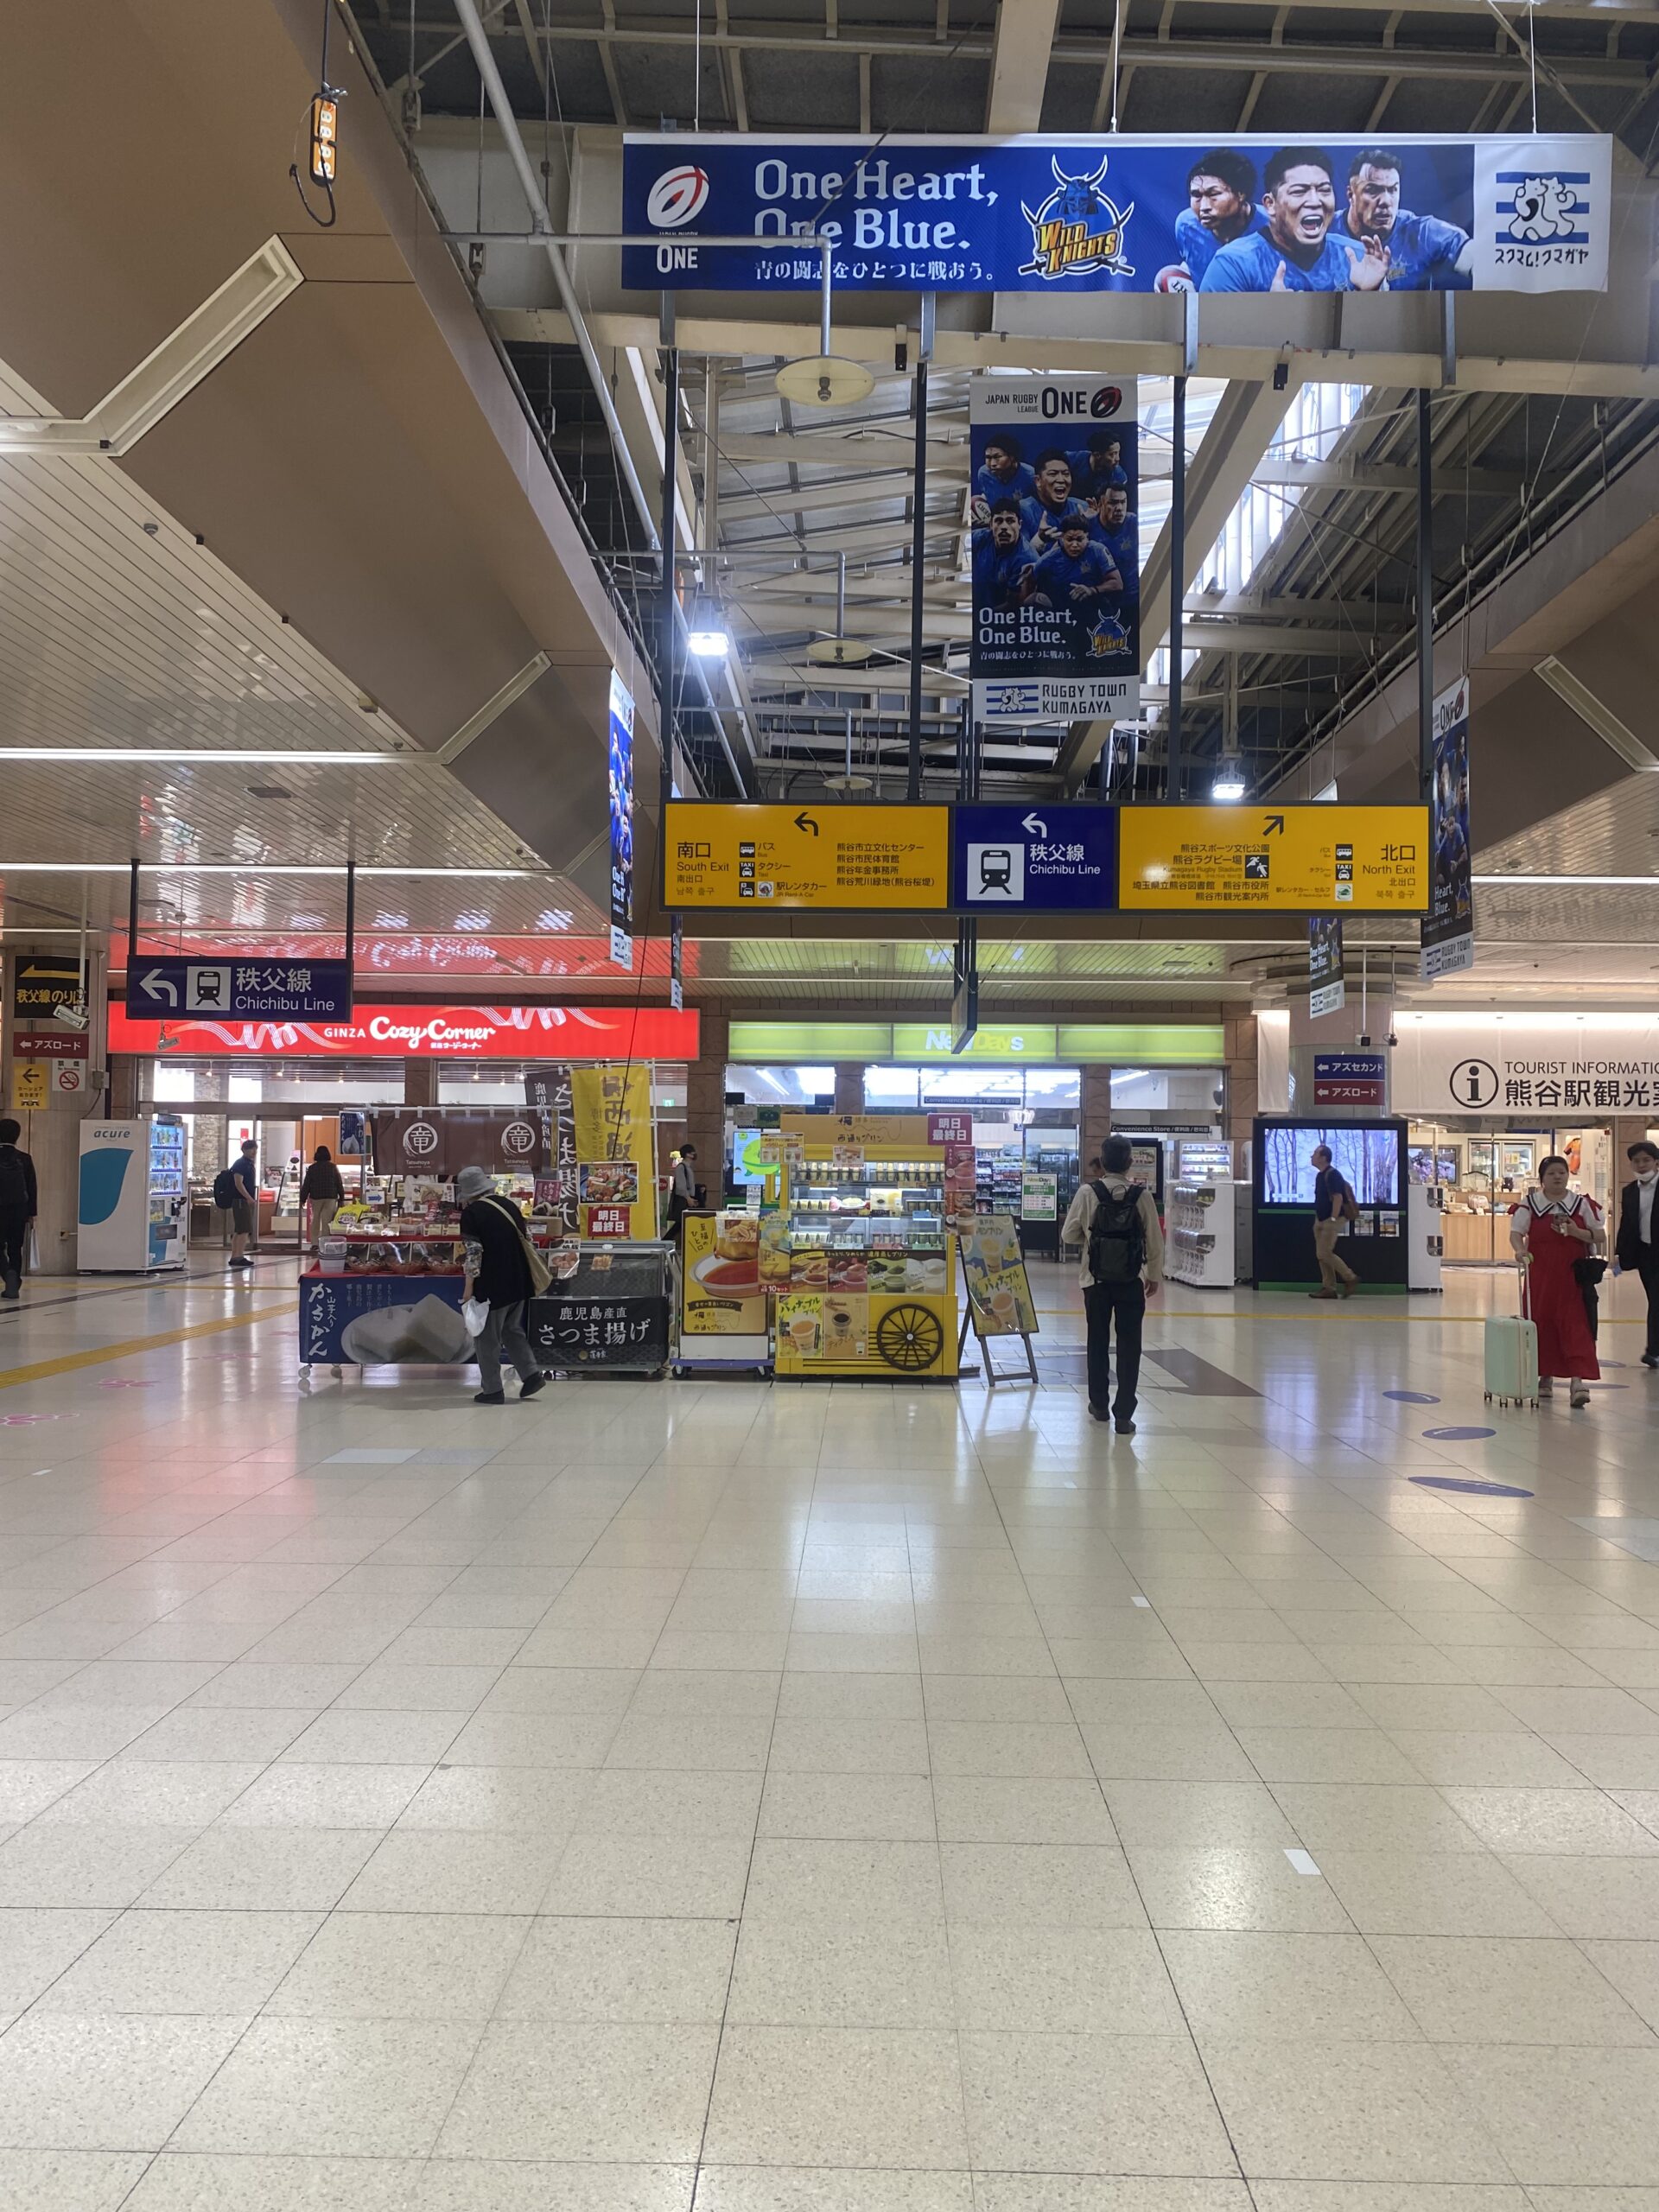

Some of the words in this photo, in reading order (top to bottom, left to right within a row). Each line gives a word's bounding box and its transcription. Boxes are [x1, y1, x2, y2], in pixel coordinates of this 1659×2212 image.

[755, 159, 843, 200] One
[854, 159, 999, 207] Heart,
[754, 208, 842, 249] One
[853, 208, 971, 250] Blue.
[985, 394, 1010, 404] JAPAN
[1013, 393, 1038, 404] RUGBY
[1041, 386, 1088, 419] ONE
[979, 607, 1015, 625] One
[1019, 607, 1077, 626] Heart,
[979, 627, 1015, 645] One
[1020, 626, 1066, 644] Blue.
[1042, 684, 1085, 697] RUGBY
[1042, 701, 1112, 714] KUMAGAYA
[677, 842, 710, 858] 南口
[836, 842, 925, 852] 熊谷市立文化センター
[1030, 843, 1084, 861] 秩父線
[1181, 843, 1270, 853] 熊谷スポーツ文化公園
[1381, 844, 1415, 861] 北口
[836, 855, 899, 863] 熊谷市民体育館
[1173, 855, 1243, 864] 熊谷ラグビー場
[677, 861, 707, 872] South
[710, 861, 729, 872] Exit
[836, 866, 899, 874] 熊谷年金事務所
[1029, 864, 1075, 874] Chichibu
[1078, 864, 1101, 874] Line
[1363, 865, 1392, 874] North
[1395, 865, 1415, 874] Exit
[677, 874, 702, 883] 南出口
[1389, 878, 1415, 887] 北出口
[777, 882, 827, 891] 駅レンタカー
[1133, 881, 1215, 890] 埼玉県立熊谷図書館
[1223, 881, 1269, 890] 熊谷市役所
[1195, 893, 1269, 901] 熊谷市観光案内所
[236, 967, 312, 993] 秩父線
[235, 996, 299, 1011] Chichibu
[303, 997, 335, 1011] Line
[324, 1027, 365, 1038] GINZA
[370, 1016, 429, 1049] Cozy
[427, 1020, 496, 1039] Corner
[35, 1040, 81, 1051] アズロード
[1332, 1063, 1382, 1072] アズセカンド
[1505, 1062, 1567, 1074] TOURIST
[1332, 1088, 1377, 1097] アズロード
[1505, 1079, 1659, 1107] 熊谷駅観光
[938, 1118, 961, 1129] 明日
[932, 1129, 967, 1141] 最終日
[598, 1210, 620, 1221] 明日
[592, 1221, 625, 1232] 最終日
[327, 1296, 337, 1328] 山芋入り
[559, 1306, 627, 1320] 鹿児島産直
[308, 1282, 332, 1357] かるかん
[538, 1319, 651, 1345] さつま揚げ
